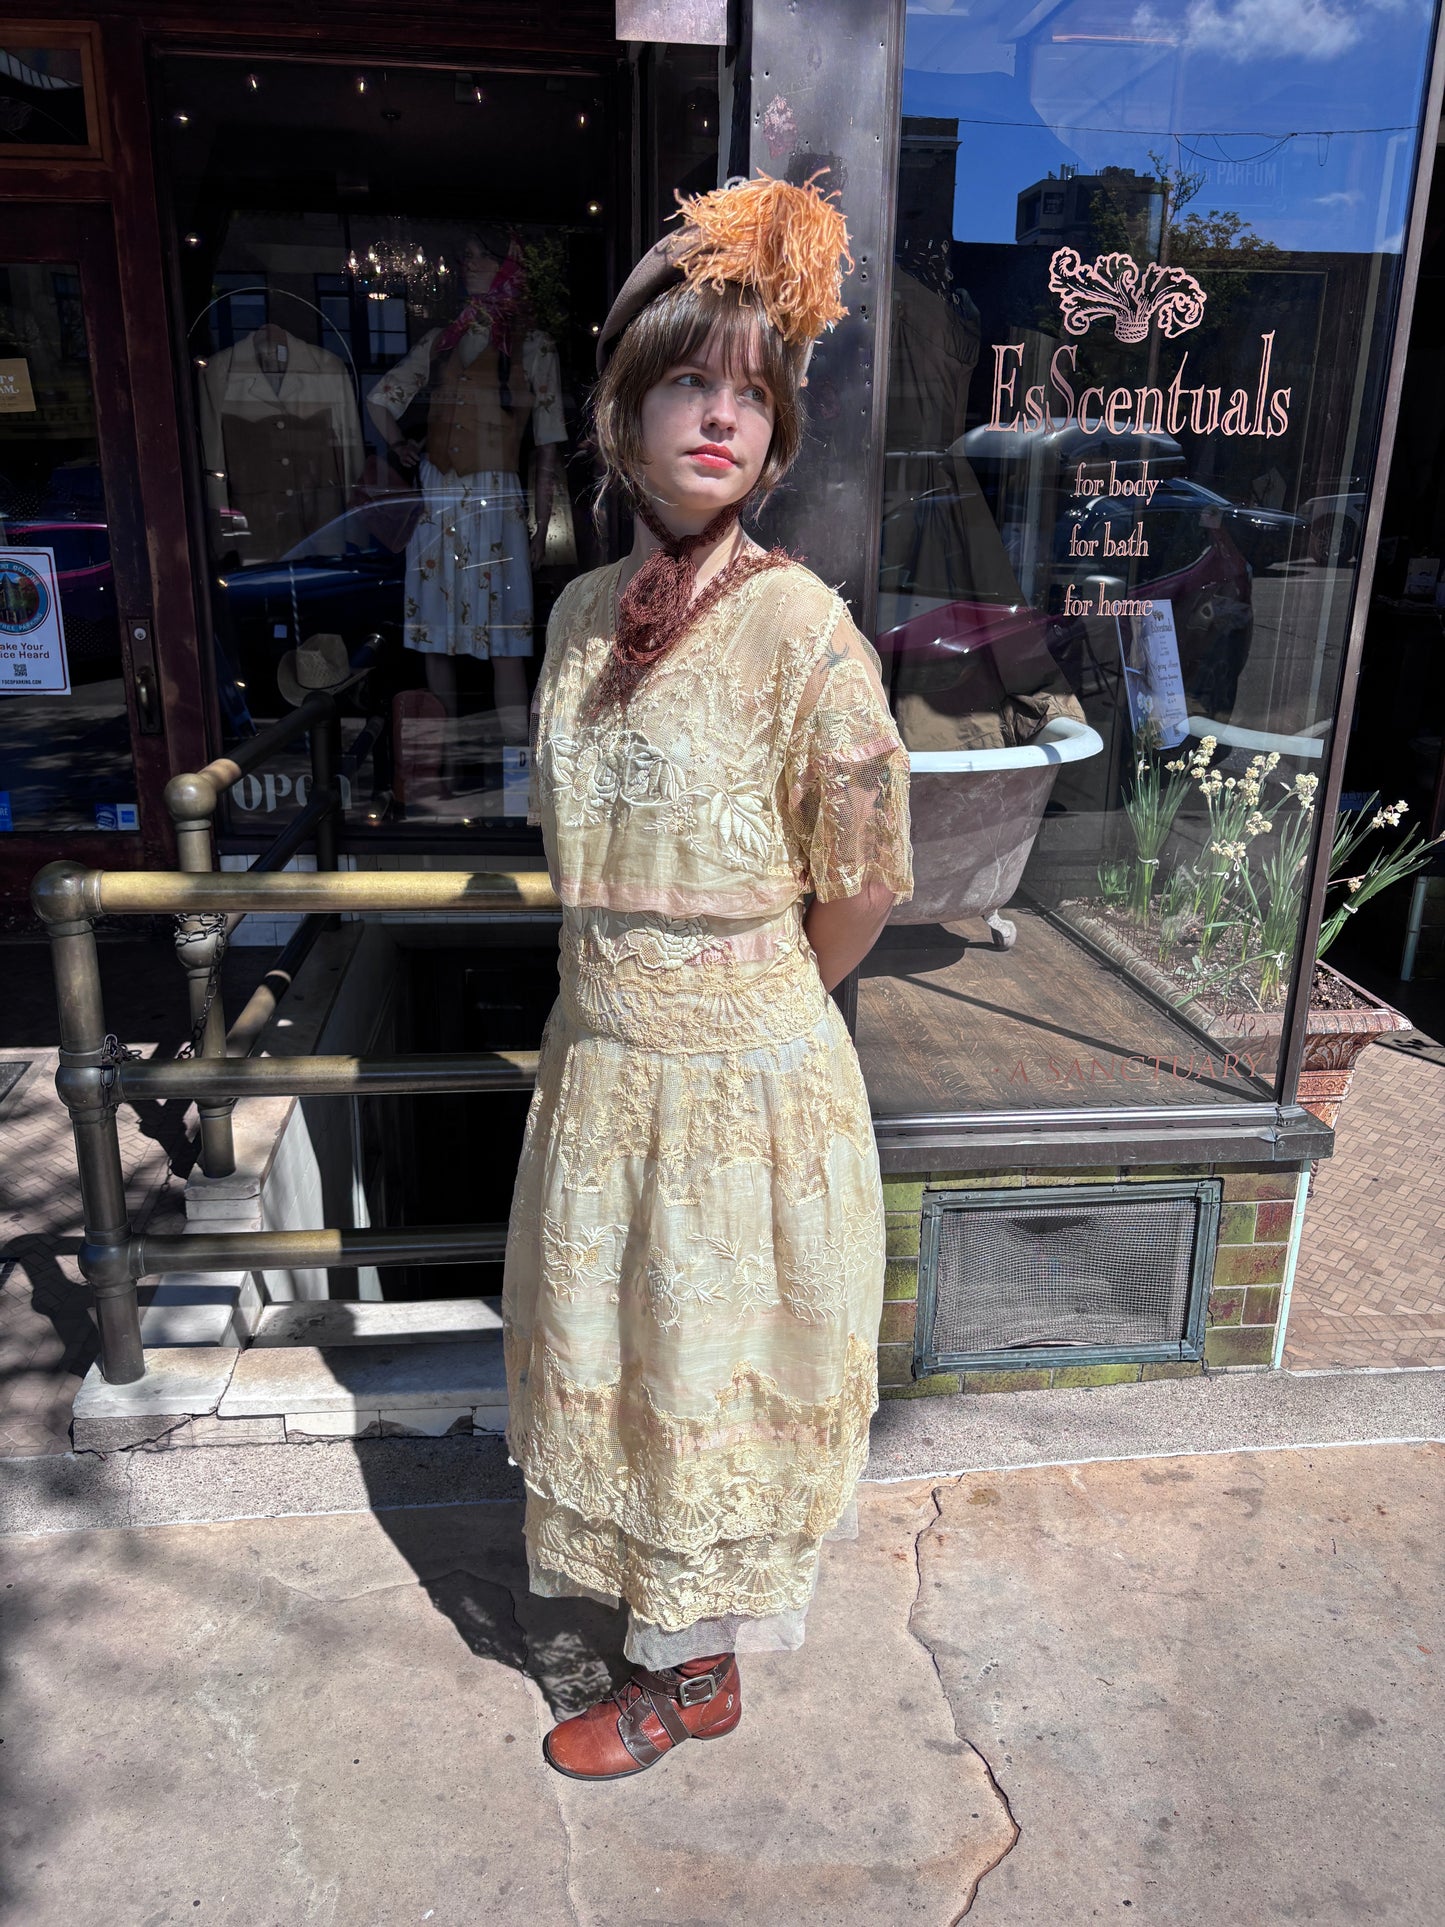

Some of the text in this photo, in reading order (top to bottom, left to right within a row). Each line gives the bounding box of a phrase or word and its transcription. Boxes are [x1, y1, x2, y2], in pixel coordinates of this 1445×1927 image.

[1216, 161, 1278, 187] PARFUM
[984, 330, 1292, 439] EsScentuals
[1073, 460, 1160, 505] for body
[1068, 521, 1150, 557] for bath
[1063, 581, 1153, 617] for home
[0, 642, 44, 651] ake Your
[0, 651, 50, 659] ice Heard
[1009, 1052, 1267, 1084] A SANCTUARY
